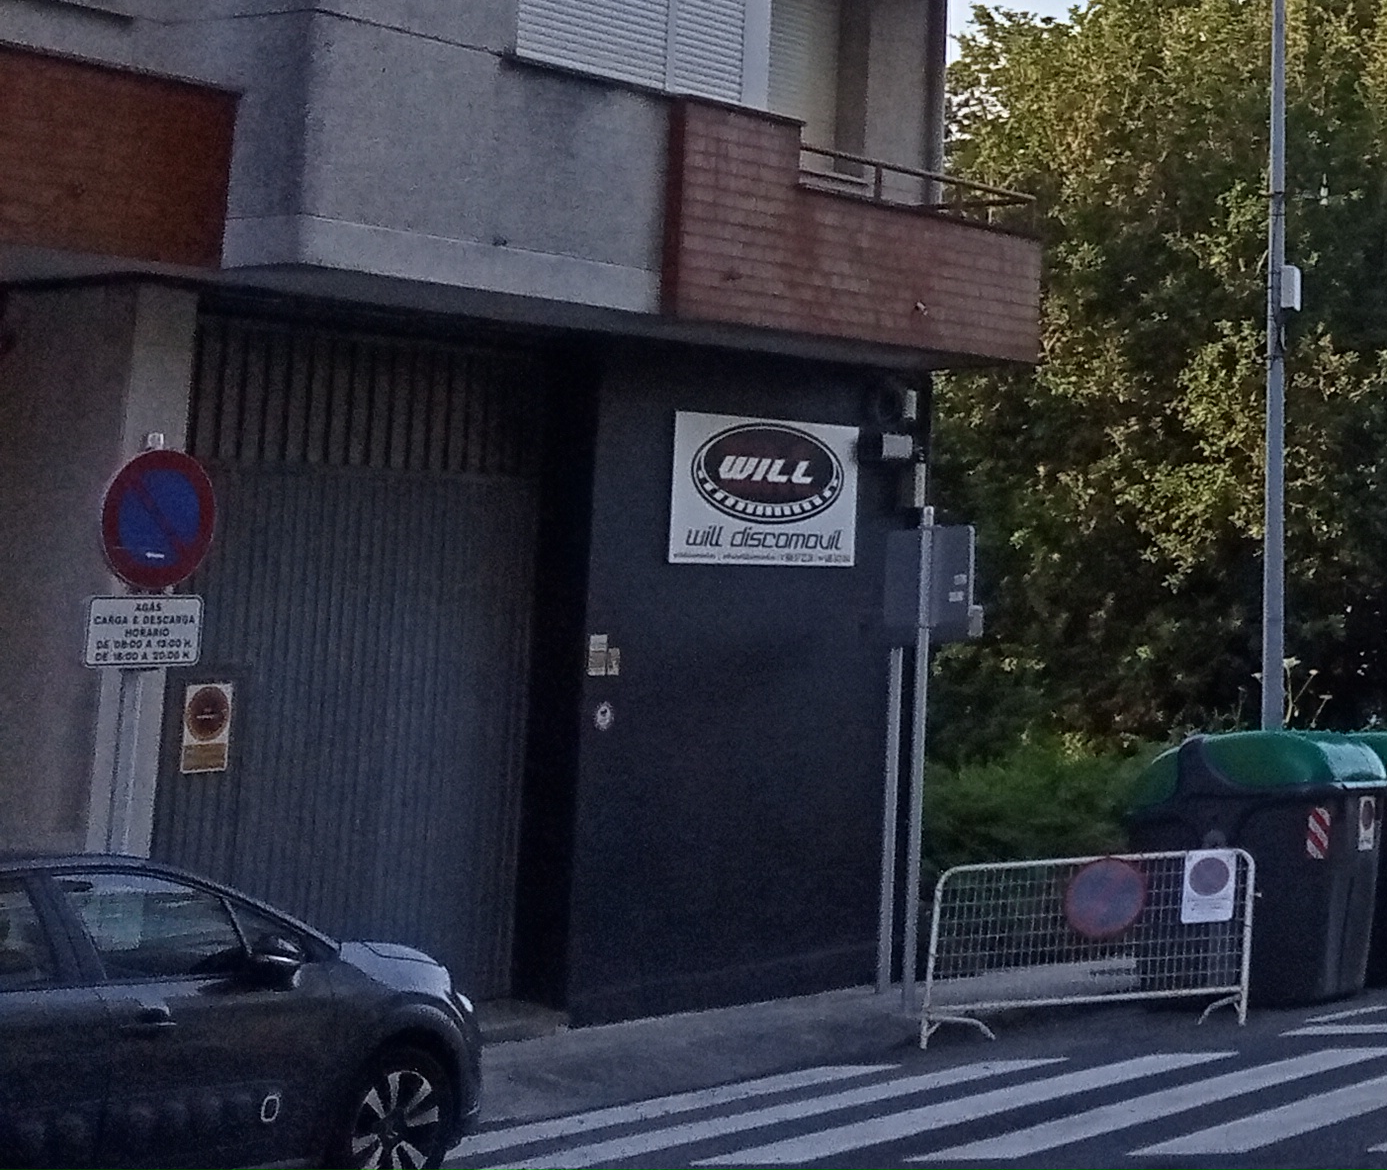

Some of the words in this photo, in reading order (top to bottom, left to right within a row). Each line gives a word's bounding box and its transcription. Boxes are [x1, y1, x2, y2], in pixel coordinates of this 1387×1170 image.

[718, 455, 814, 484] WILL
[685, 525, 724, 548] will
[730, 526, 844, 551] discomovil
[93, 615, 128, 625] CARGA
[142, 615, 195, 625] DESCARGA
[124, 628, 170, 637] HORARIO
[96, 640, 109, 650] DE
[145, 639, 152, 648] A
[95, 652, 108, 662] DE
[141, 652, 148, 660] A
